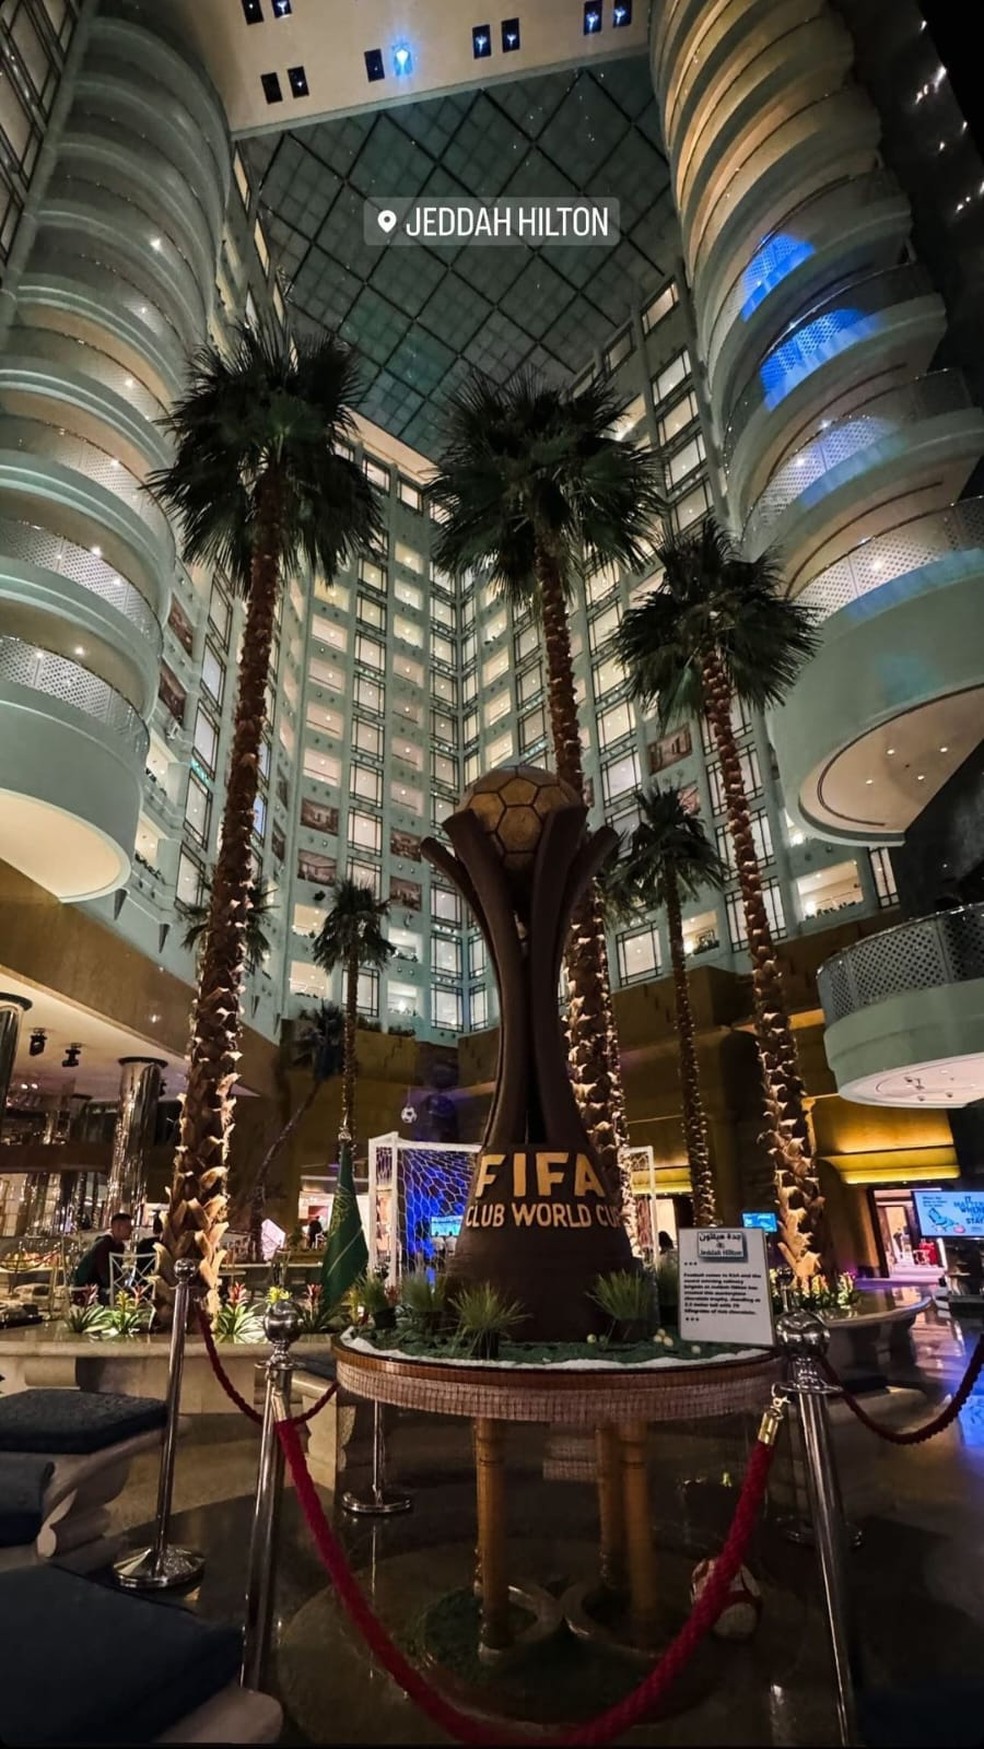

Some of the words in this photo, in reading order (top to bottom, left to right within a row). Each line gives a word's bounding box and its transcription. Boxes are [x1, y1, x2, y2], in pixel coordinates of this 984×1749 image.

[475, 1152, 606, 1198] FIFA
[465, 1203, 505, 1227] CLUB
[511, 1202, 592, 1228] WORLD
